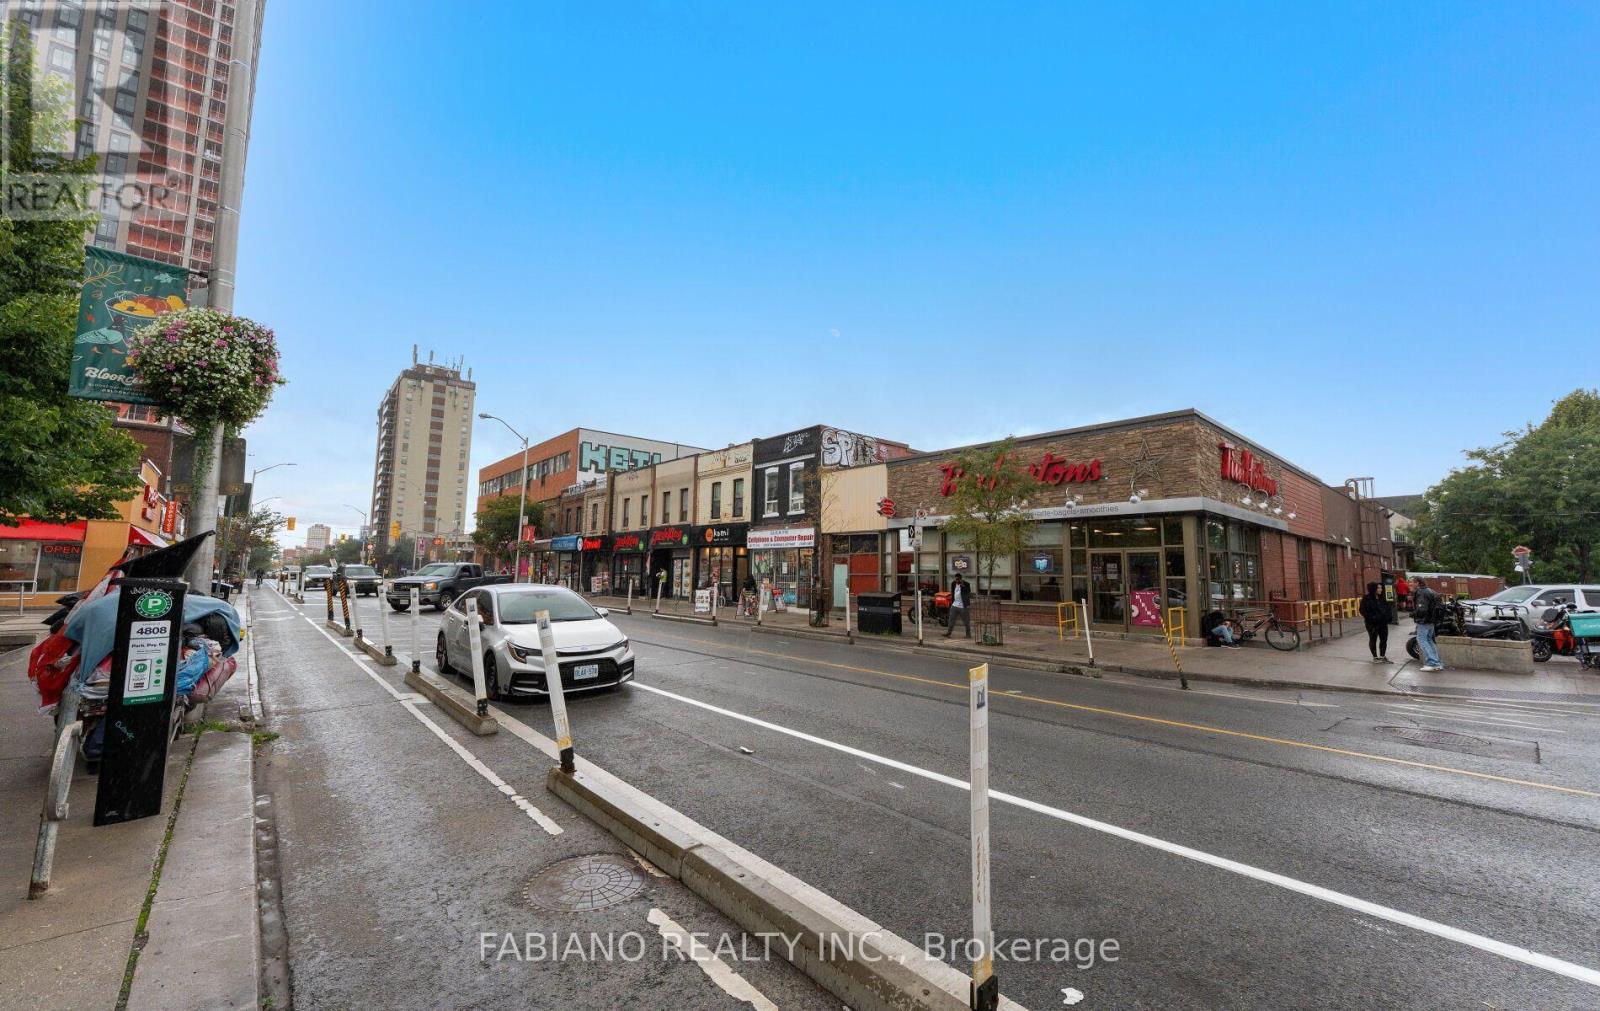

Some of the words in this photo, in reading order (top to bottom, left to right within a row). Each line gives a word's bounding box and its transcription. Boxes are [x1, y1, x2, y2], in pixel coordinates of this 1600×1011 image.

[44, 545, 80, 553] OPEN
[147, 599, 162, 609] P
[136, 627, 167, 635] 4808
